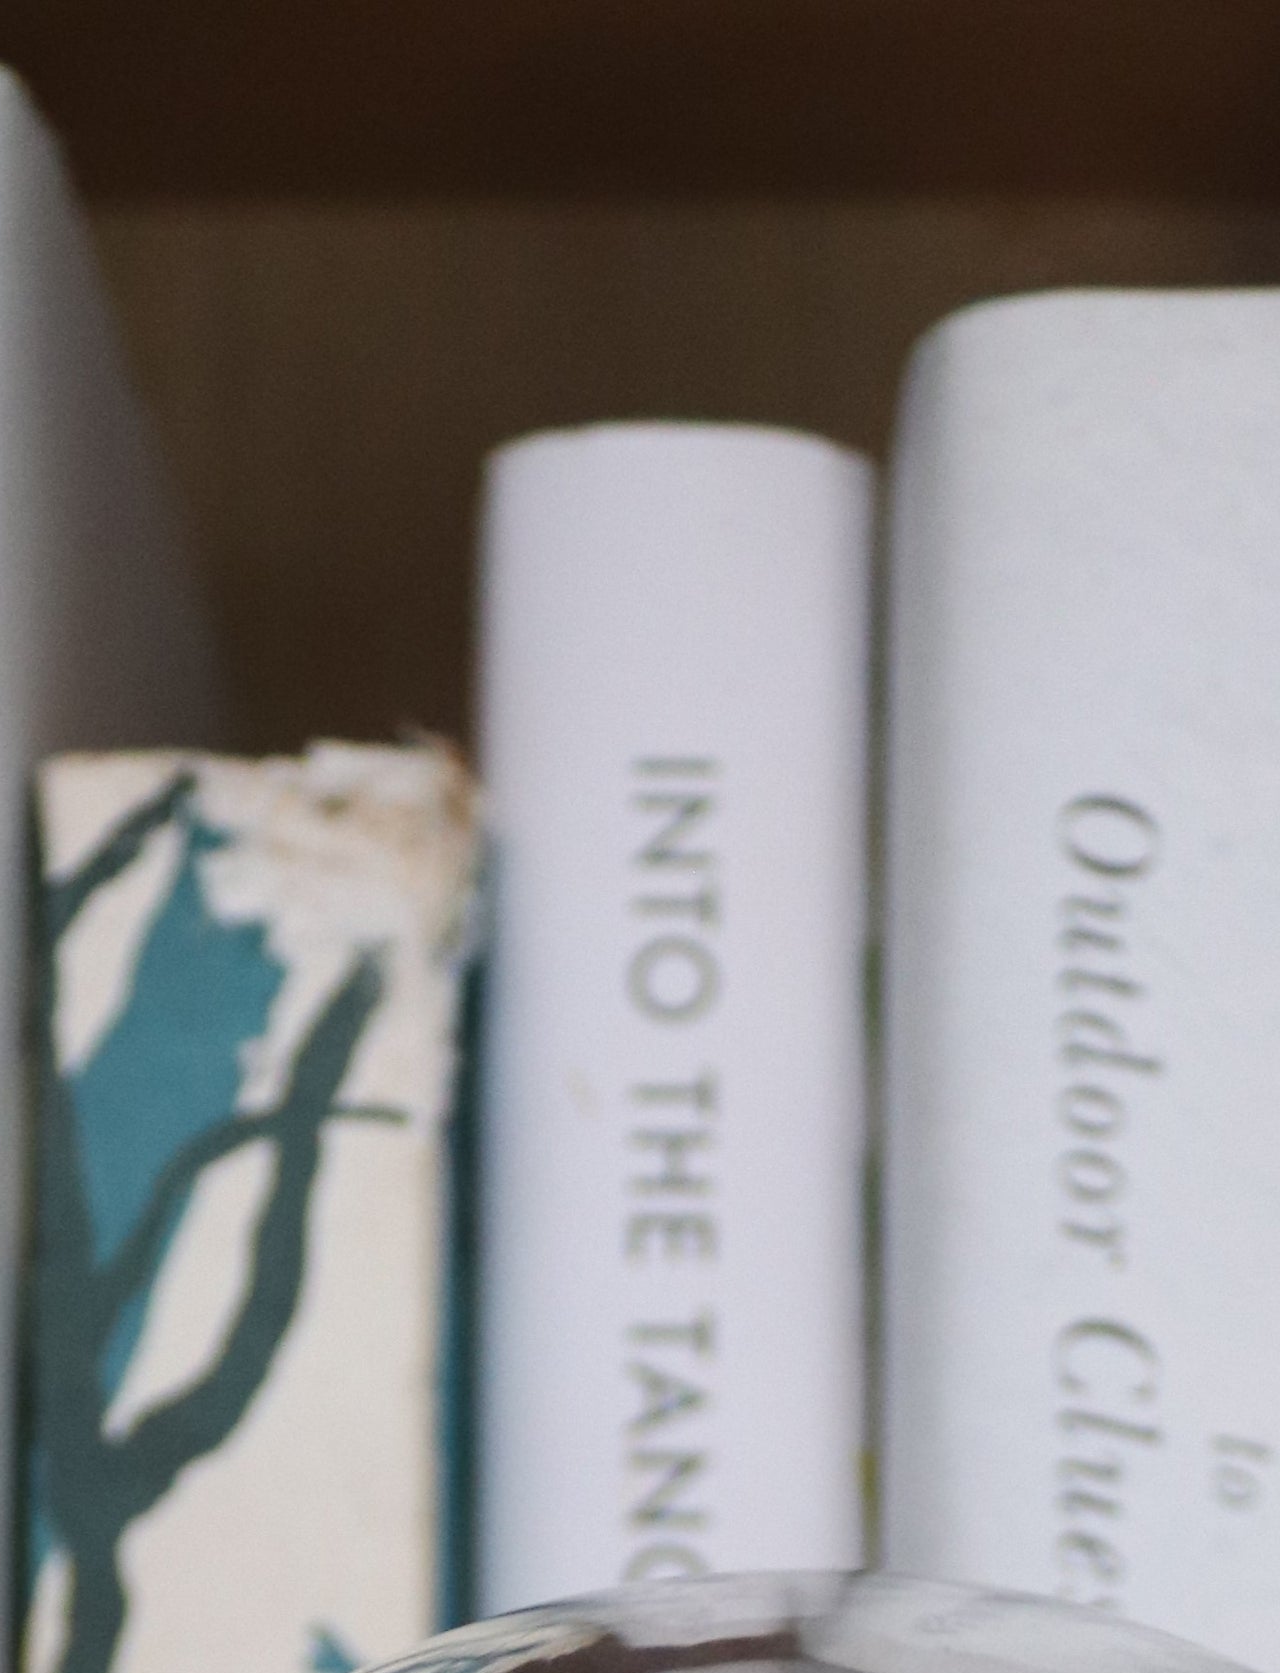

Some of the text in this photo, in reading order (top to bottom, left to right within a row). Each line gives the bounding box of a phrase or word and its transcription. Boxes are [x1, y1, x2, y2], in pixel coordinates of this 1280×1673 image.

[624, 752, 719, 1026] INTO
[624, 1074, 718, 1264] THE
[1052, 790, 1166, 1602] Outdoor Clue
